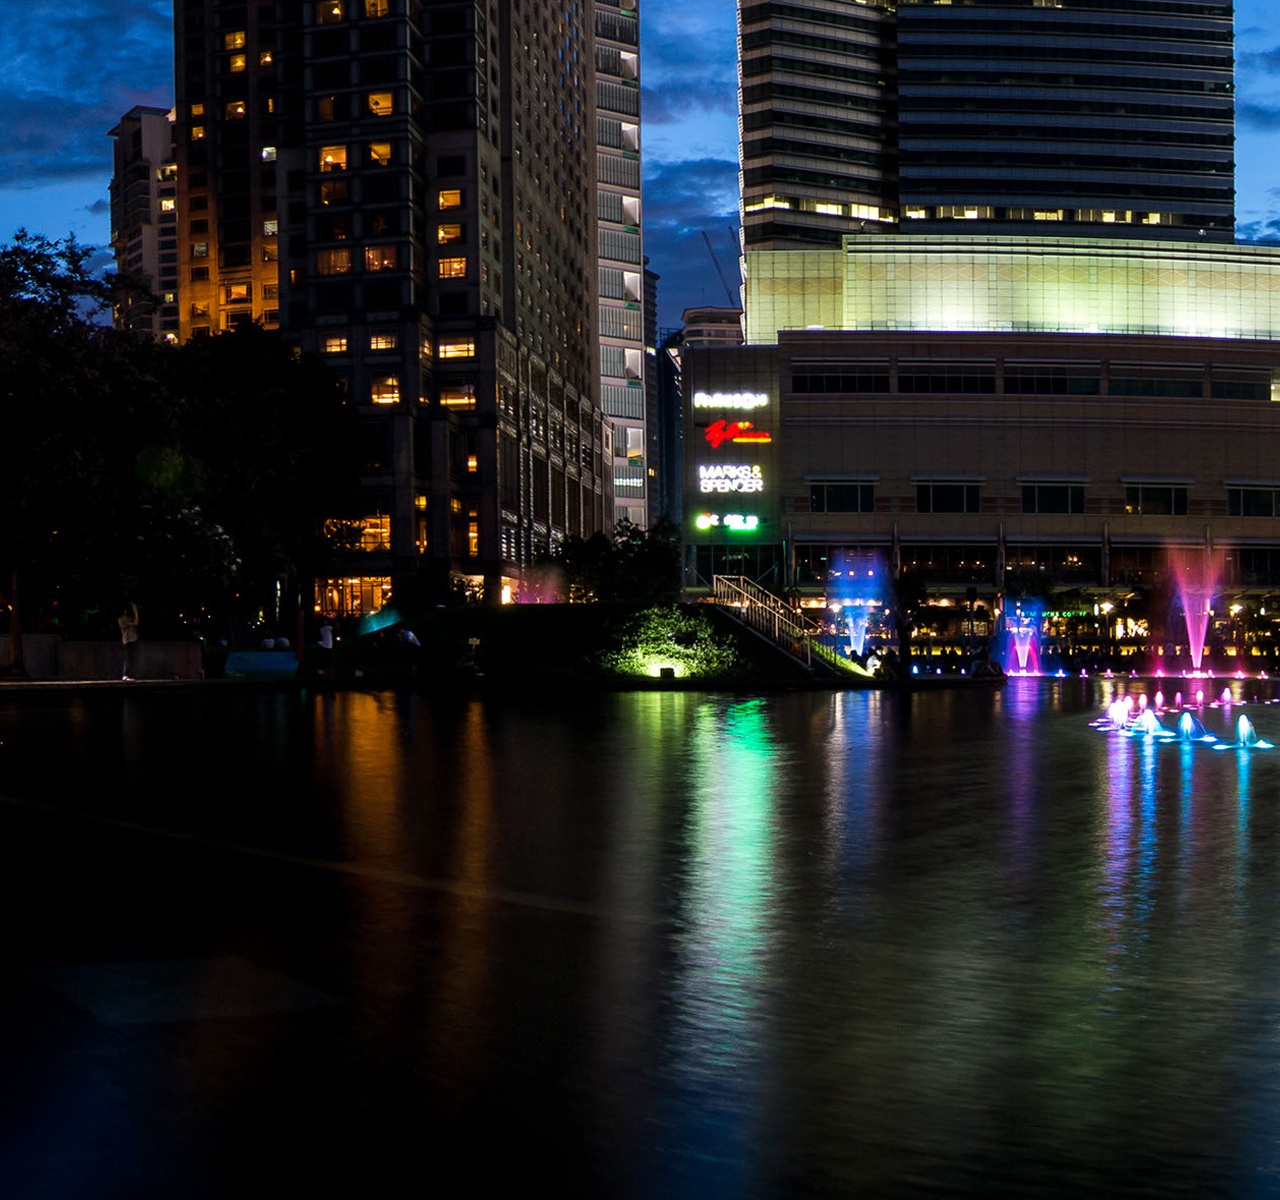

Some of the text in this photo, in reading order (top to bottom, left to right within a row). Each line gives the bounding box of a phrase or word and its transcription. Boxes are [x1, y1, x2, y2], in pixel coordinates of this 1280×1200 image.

[699, 465, 763, 479] MARKS &
[700, 479, 764, 493] SPENCER
